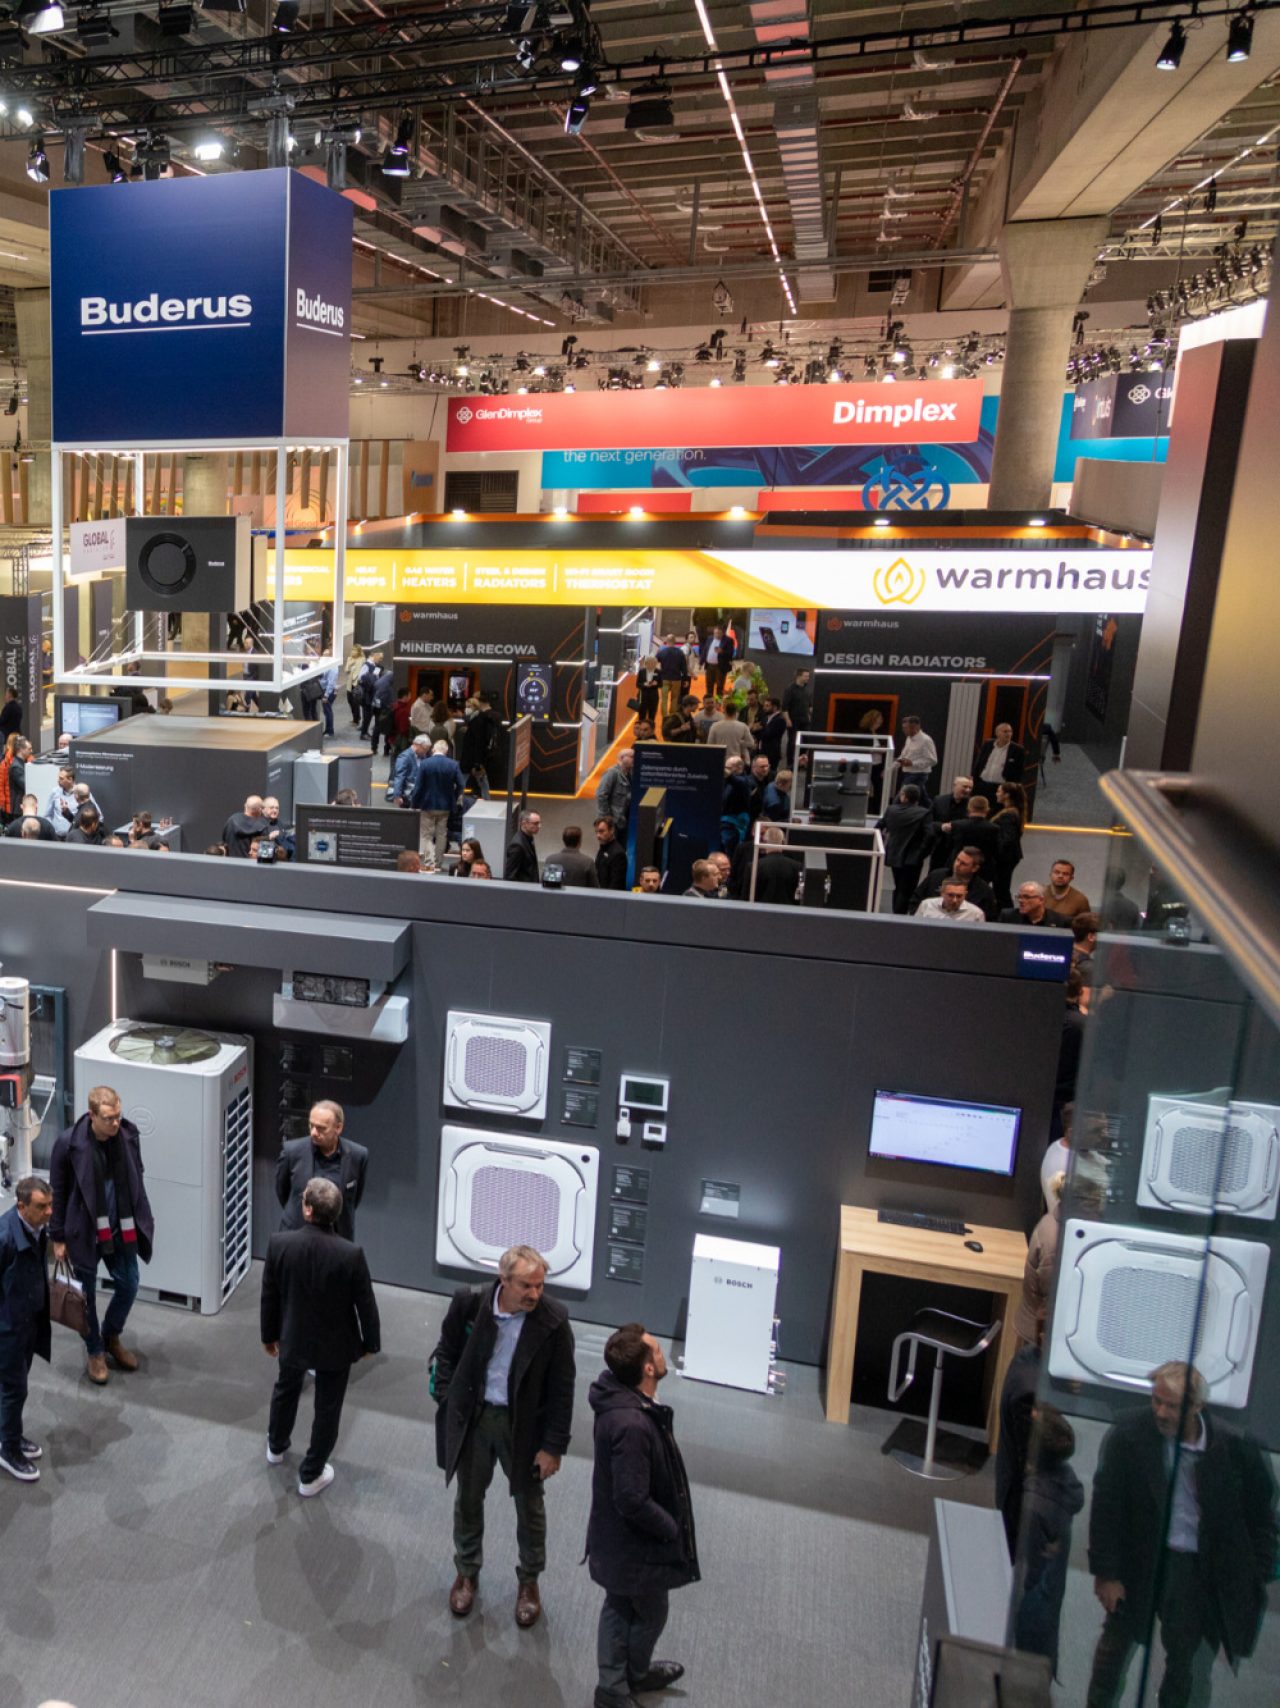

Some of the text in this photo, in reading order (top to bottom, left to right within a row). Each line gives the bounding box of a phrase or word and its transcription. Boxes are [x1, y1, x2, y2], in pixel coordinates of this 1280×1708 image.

[80, 294, 252, 326] Buderus
[296, 288, 344, 328] Buderus
[475, 407, 543, 420] GlenDimplex
[832, 399, 957, 424] Dimplex
[563, 448, 707, 465] the next generation.
[82, 531, 110, 547] GLOBAL
[346, 576, 386, 587] PUMPS
[402, 576, 457, 588] HEATERS
[936, 561, 1152, 590] warmhaus
[474, 578, 547, 589] RADIATORS
[565, 579, 654, 590] THERMOSTAT
[412, 611, 458, 620] warmhaus
[843, 617, 899, 629] warmhaus
[400, 642, 537, 656] MINERWA & RECOWA
[823, 652, 987, 669] DESIGN RADIATORS
[1023, 950, 1066, 963] Buderus
[726, 1278, 753, 1289] BOSCH
